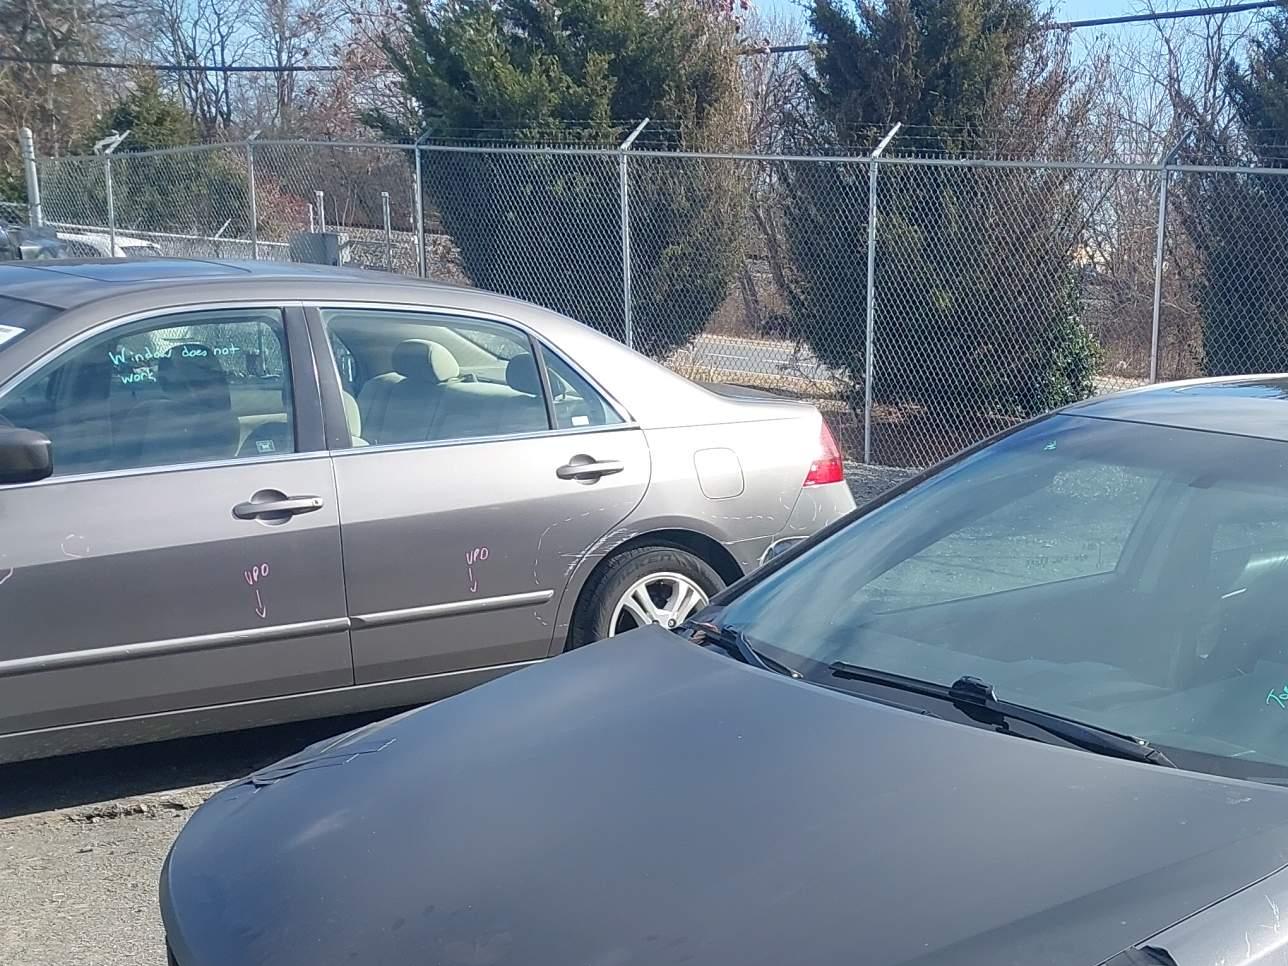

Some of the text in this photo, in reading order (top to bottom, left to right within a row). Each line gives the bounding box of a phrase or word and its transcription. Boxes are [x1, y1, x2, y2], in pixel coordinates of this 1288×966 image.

[109, 343, 240, 365] Window does not
[121, 368, 157, 383] work
